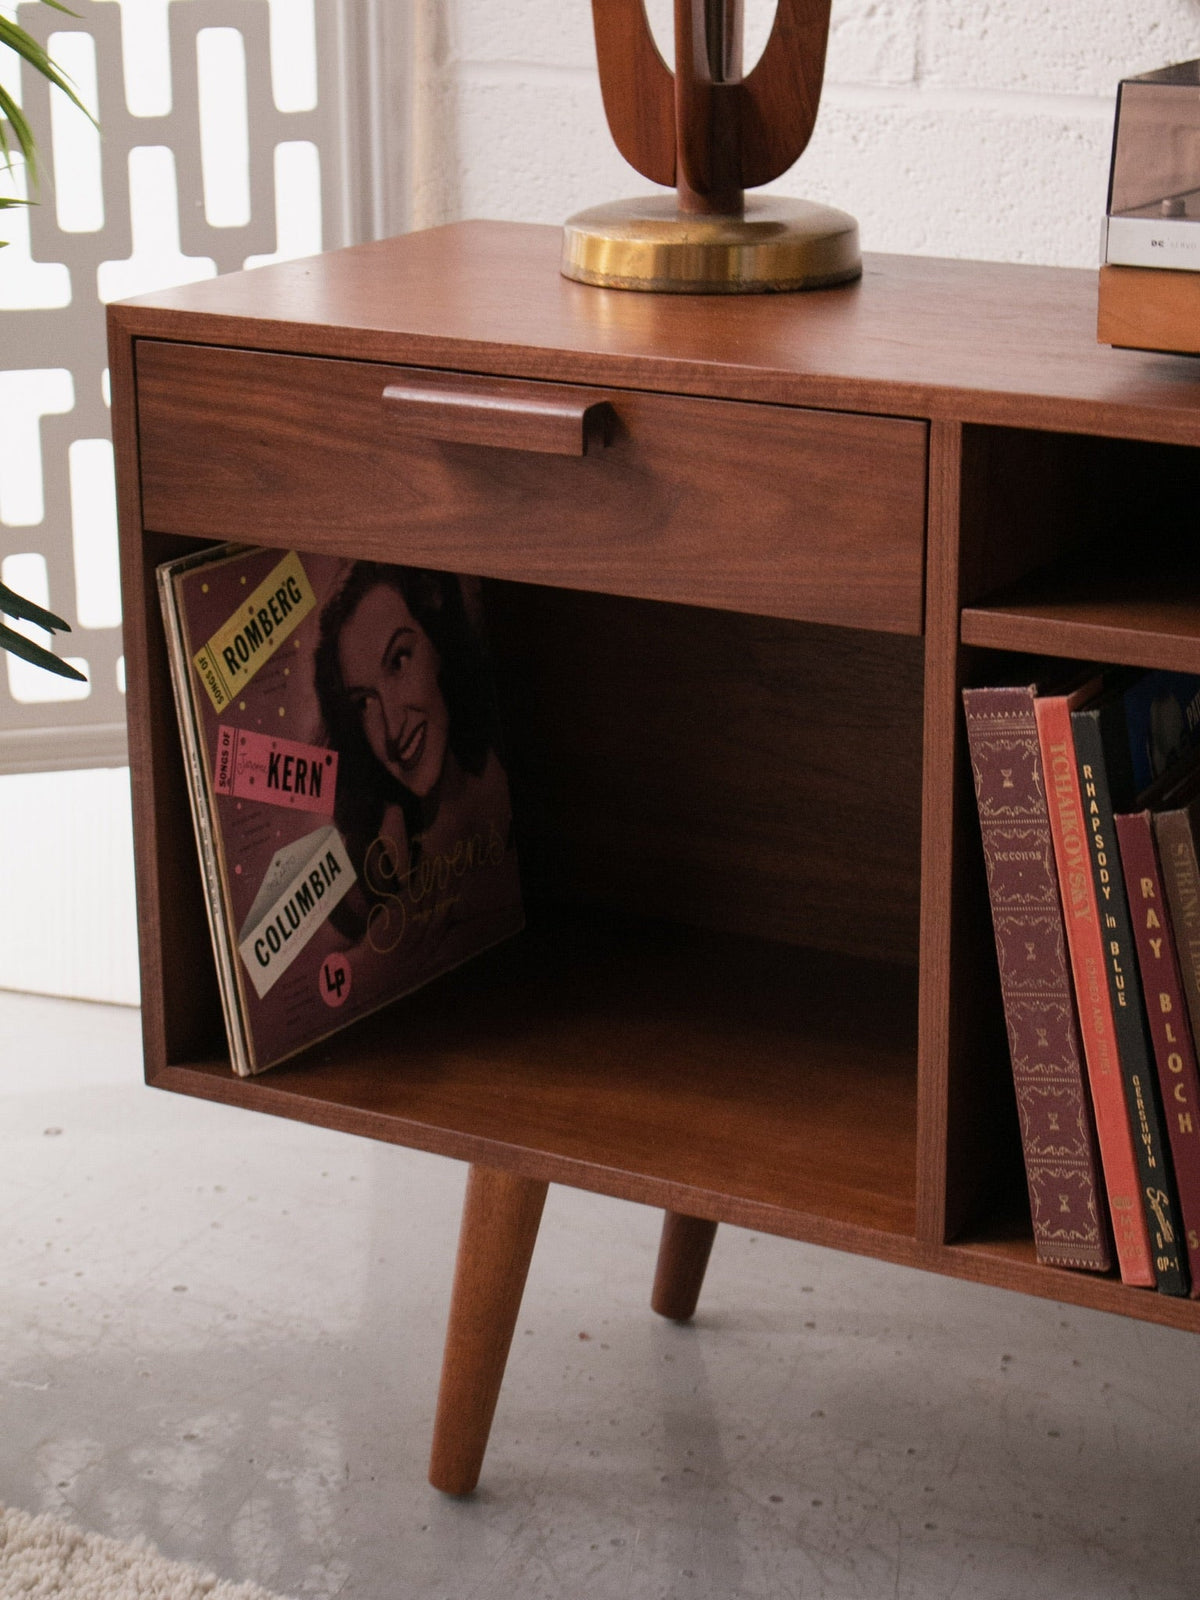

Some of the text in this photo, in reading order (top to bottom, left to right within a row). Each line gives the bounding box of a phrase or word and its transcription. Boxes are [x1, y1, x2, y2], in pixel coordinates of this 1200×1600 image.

[222, 576, 302, 676] ROMBERG
[198, 656, 225, 705] SONGS OF
[219, 731, 231, 788] SONGS OF
[267, 751, 323, 798] KERN
[1050, 741, 1095, 923] TCHAIKOVSKY
[1083, 763, 1128, 1007] RHAPSODY in BLUE
[254, 850, 342, 967] COLUMBIA
[1140, 876, 1193, 1135] RAY BLOCH
